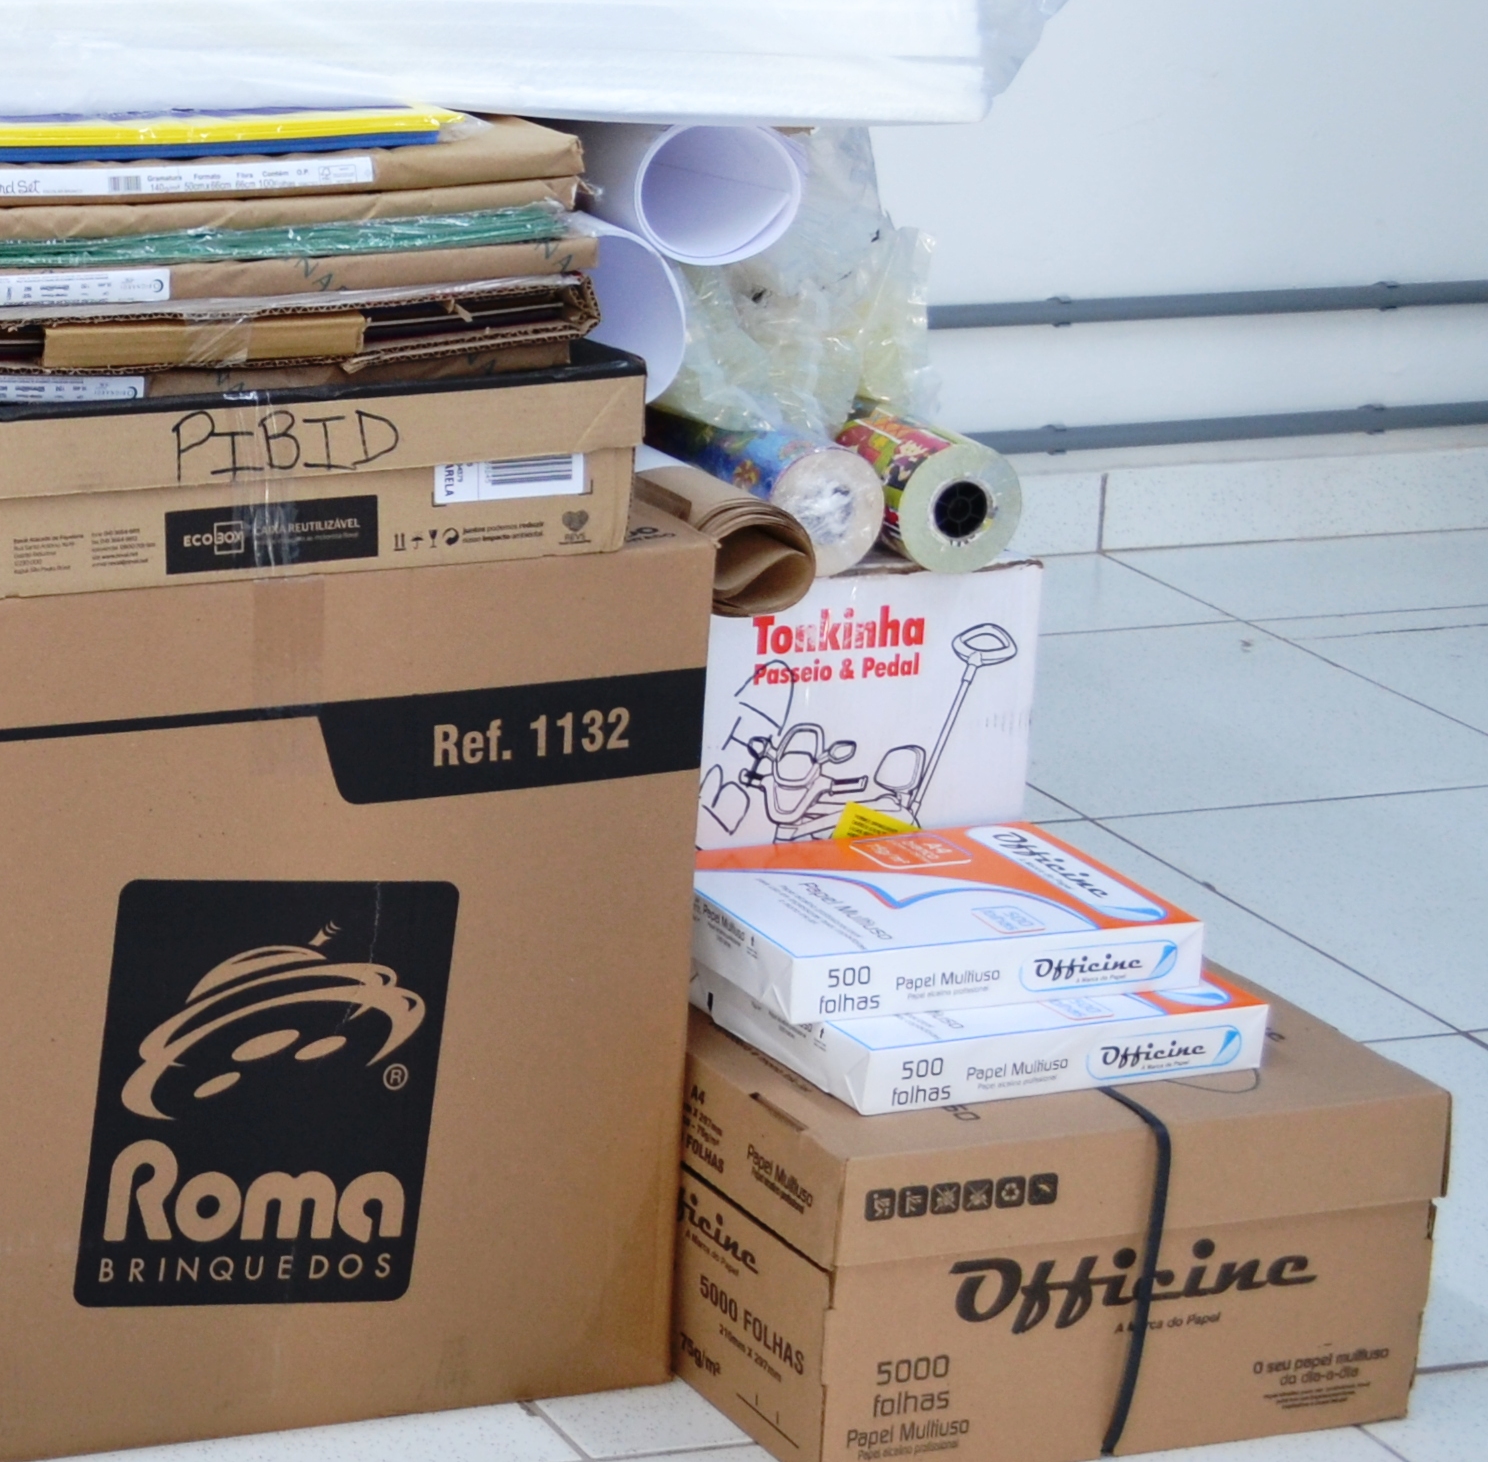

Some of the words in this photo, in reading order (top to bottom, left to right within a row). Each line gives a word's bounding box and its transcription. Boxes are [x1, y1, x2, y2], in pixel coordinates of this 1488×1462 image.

[17, 179, 41, 195] Set
[173, 410, 400, 483] PIBID
[288, 517, 361, 534] REUTILIZÁVEL
[752, 604, 926, 656] Tonkinha
[753, 656, 833, 687] Passeio
[839, 656, 855, 680] &
[862, 651, 920, 680] Pedal
[431, 718, 513, 769] Ref.
[528, 706, 631, 758] 1132
[992, 830, 1110, 900] Officine
[799, 881, 839, 909] Papel
[828, 965, 871, 988] 500
[896, 973, 936, 993] Papel
[940, 966, 1001, 985] Multiuso
[1032, 953, 1143, 985] Officine
[818, 994, 881, 1015] folhas
[901, 1056, 945, 1082] 500
[966, 1063, 1008, 1084] Papel
[1011, 1056, 1069, 1076] Multiuso
[1100, 1039, 1207, 1072] Officine
[691, 1084, 706, 1106] A4
[890, 1081, 952, 1108] folhas
[686, 1133, 725, 1175] FOLHAS
[102, 1138, 407, 1244] Roma
[746, 1142, 774, 1178] Papel
[774, 1164, 815, 1209] Multiuso
[97, 1251, 394, 1284] BRINQUEDOS
[948, 1237, 1318, 1335] Officine
[699, 1273, 739, 1324] 5000
[743, 1308, 805, 1376] FOLHAS
[1186, 1311, 1221, 1328] Papel
[876, 1353, 951, 1387] 5000
[1294, 1353, 1334, 1373] papel
[872, 1389, 951, 1418] folhas
[846, 1425, 895, 1450] Papel
[898, 1418, 971, 1443] Multiuso
